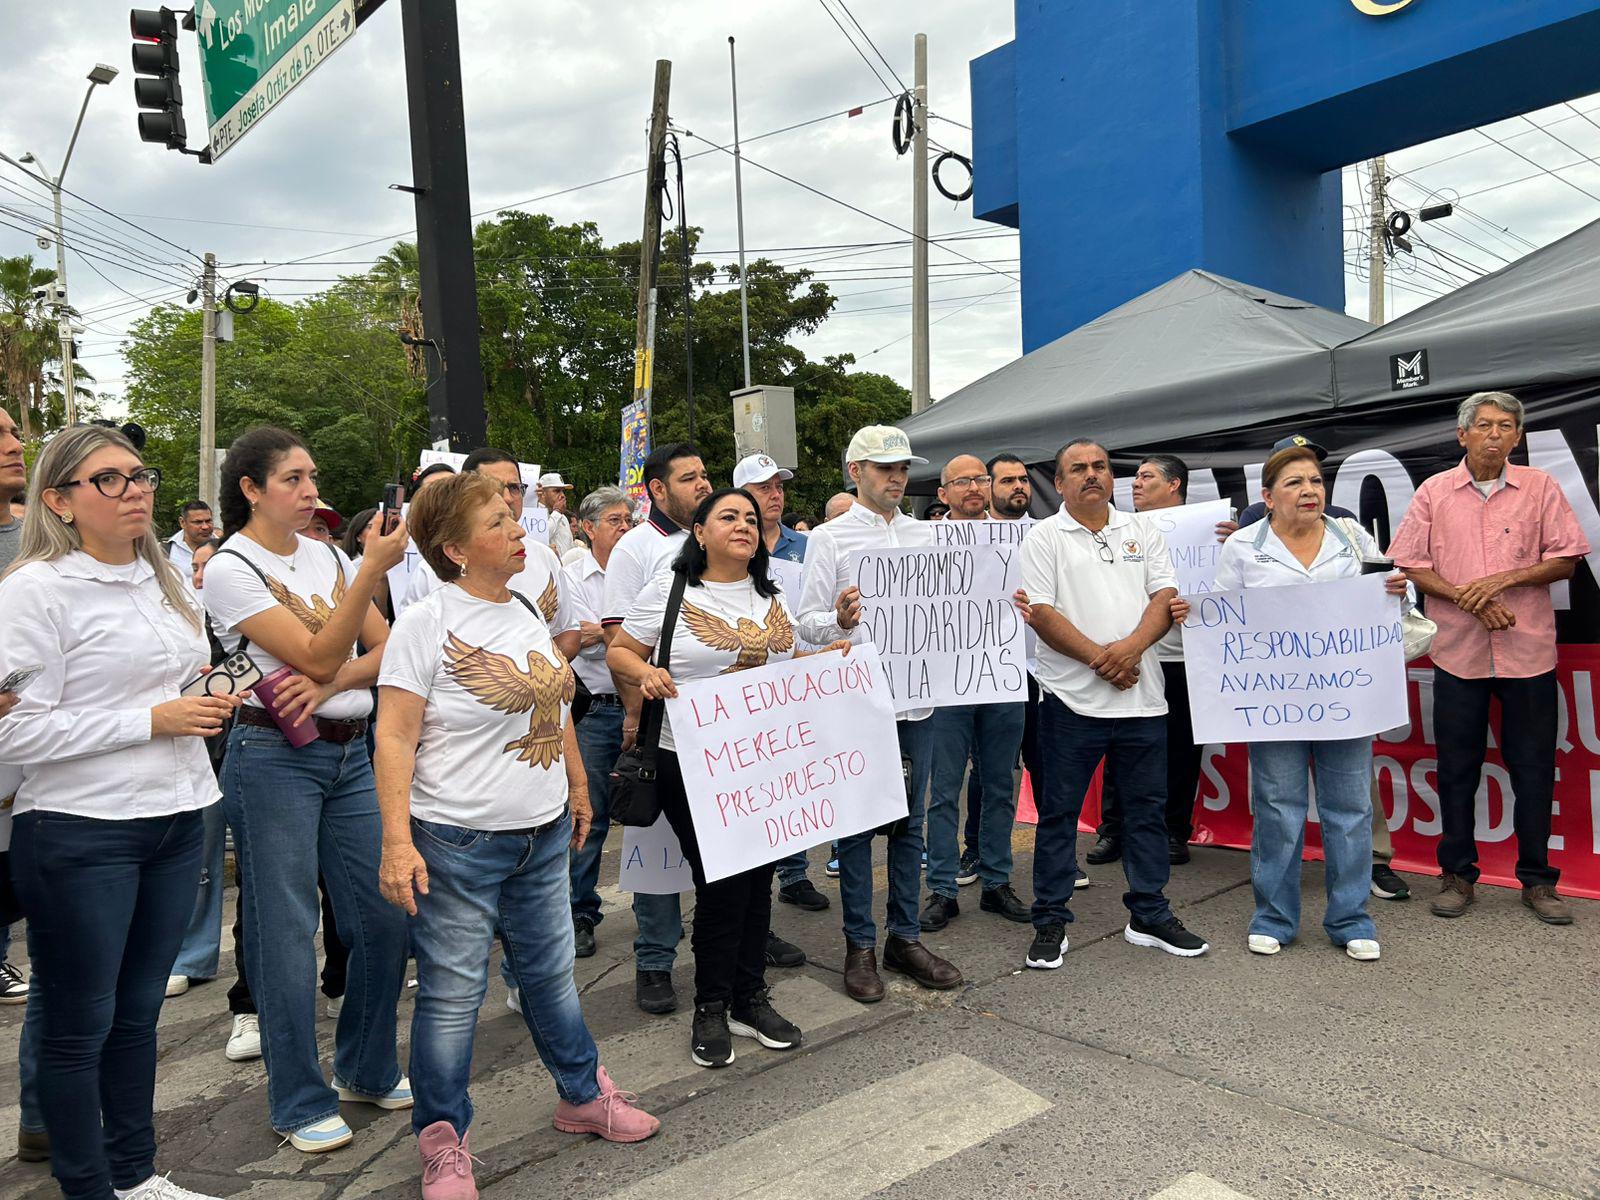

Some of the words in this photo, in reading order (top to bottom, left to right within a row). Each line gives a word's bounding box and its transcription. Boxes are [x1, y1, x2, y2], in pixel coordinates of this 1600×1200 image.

[219, 9, 242, 51] Los
[244, 0, 270, 25] Mo
[238, 93, 265, 132] Josefa
[289, 57, 302, 83] de
[304, 44, 316, 71] D.
[317, 18, 340, 56] OTE.
[930, 521, 977, 546] ERNO
[858, 550, 974, 599] COMPROMISO
[995, 549, 1012, 591] Y
[1222, 621, 1404, 664] RESPONSABILIDAD
[690, 693, 730, 728] LA
[742, 659, 873, 715] EDUCACIÓN
[882, 660, 896, 699] N
[908, 659, 931, 699] LA
[954, 648, 1022, 696] UAS
[1221, 668, 1373, 693] AVANZAMOS
[1235, 701, 1351, 727] TODOS
[704, 720, 816, 777] MERECE
[715, 750, 866, 827] PRESUPUESTO
[764, 798, 835, 848] DIGNO
[626, 845, 644, 870] A
